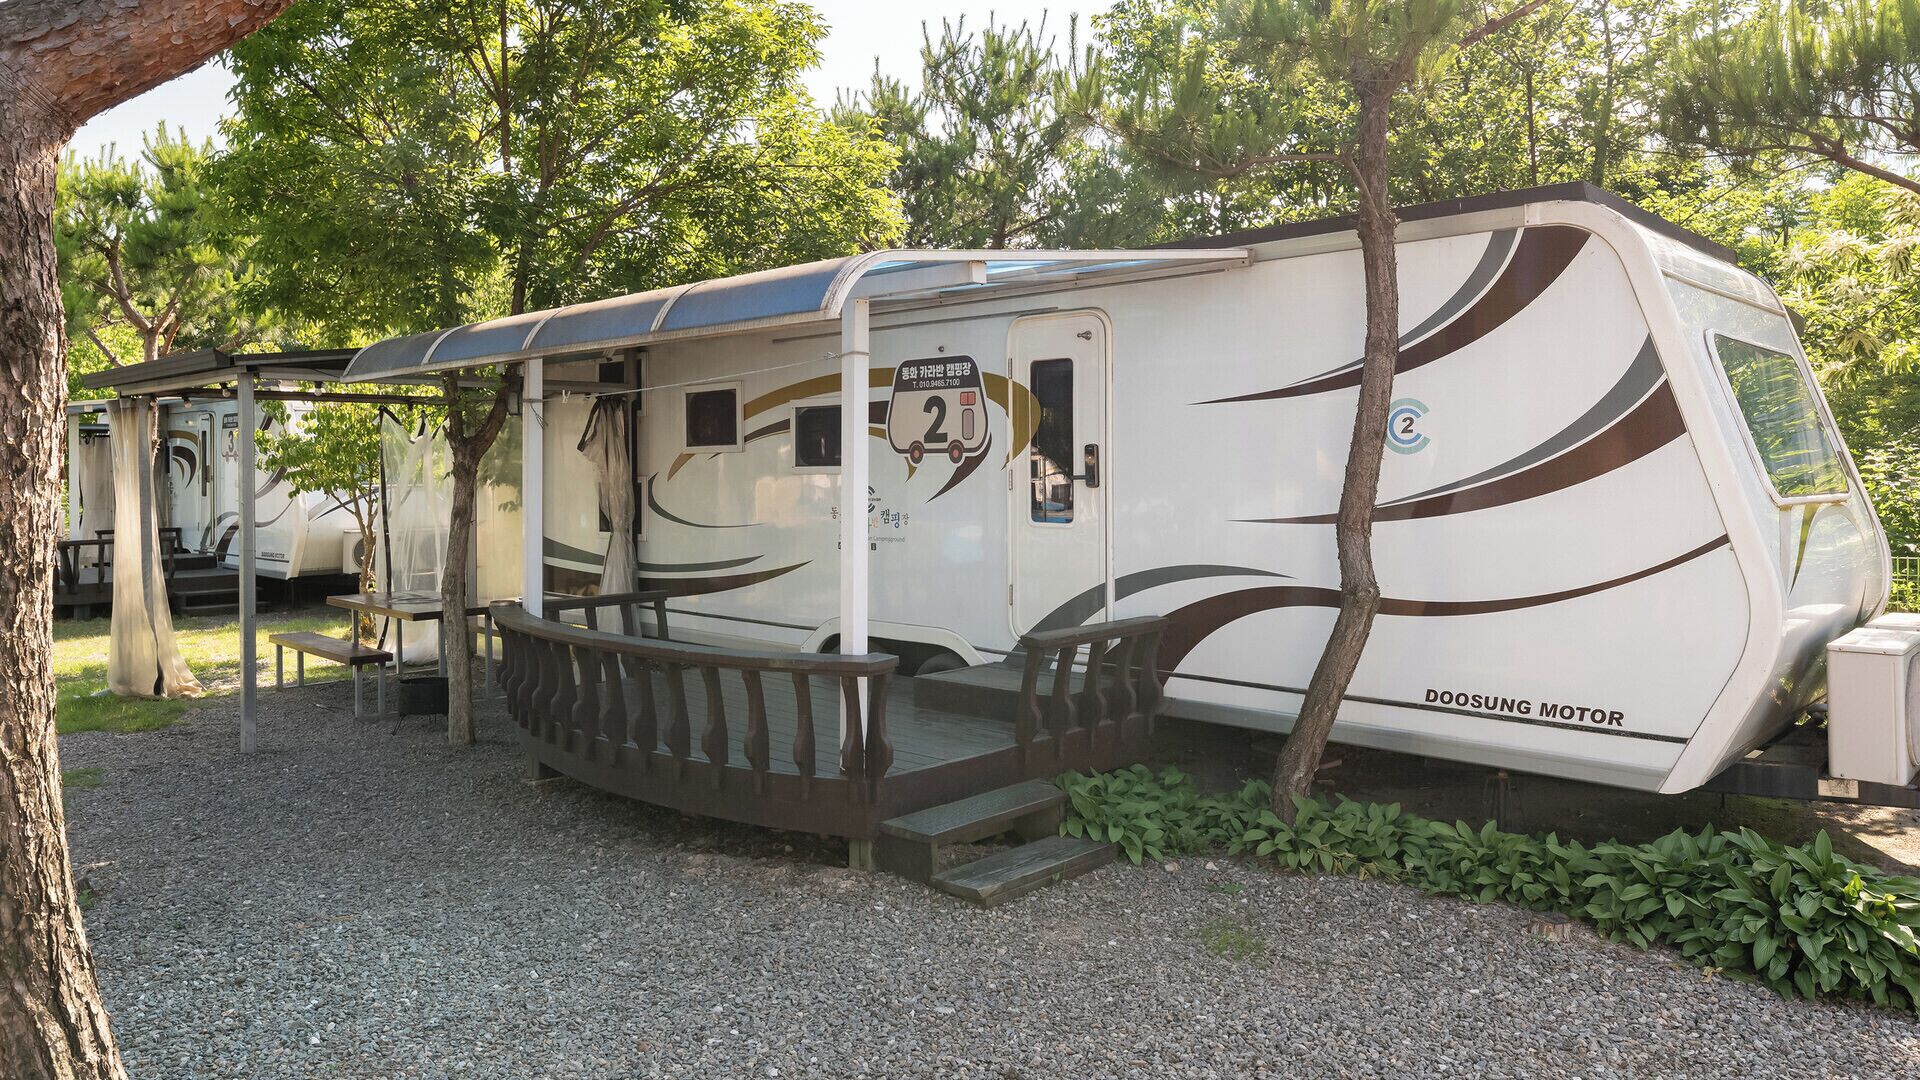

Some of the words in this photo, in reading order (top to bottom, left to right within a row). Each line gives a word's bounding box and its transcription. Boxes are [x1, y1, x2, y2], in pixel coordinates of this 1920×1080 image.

[902, 367, 918, 380] 동화
[920, 364, 944, 378] 카라반
[946, 362, 971, 376] 캠핑장
[923, 395, 948, 443] 2
[1401, 416, 1414, 433] 2
[228, 430, 234, 452] 3
[881, 508, 909, 528] 캠핑장
[1425, 688, 1532, 714] DOOSUNG
[1539, 702, 1624, 726] MOTOR
